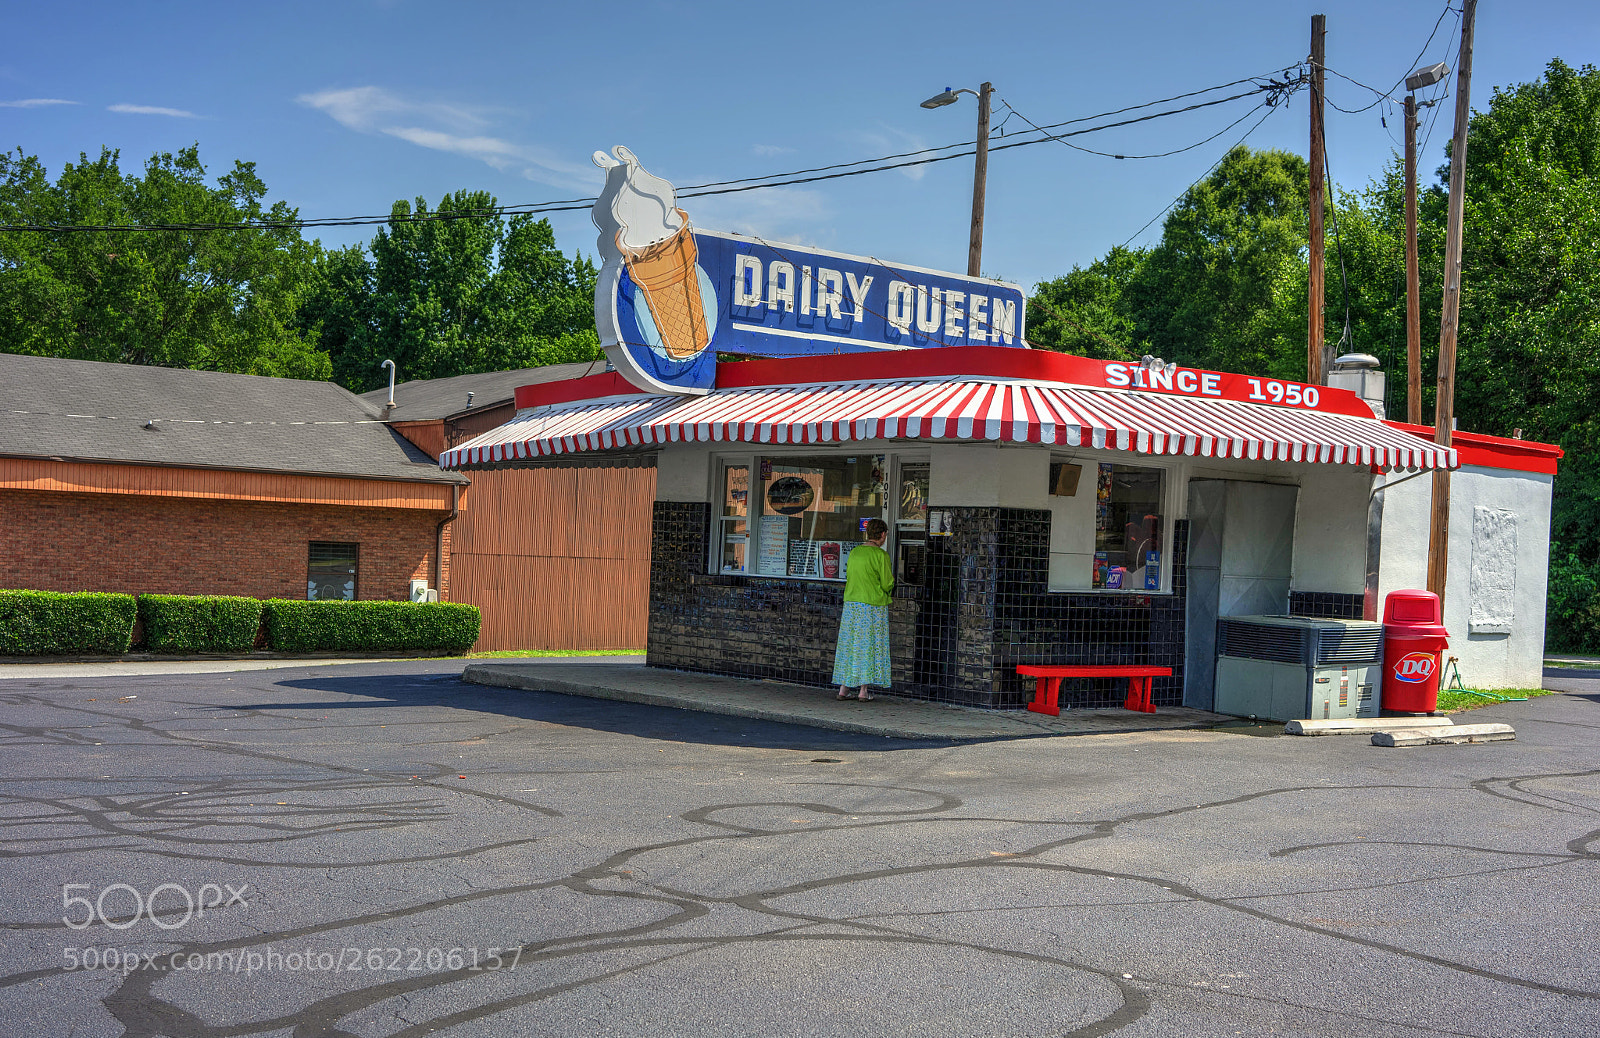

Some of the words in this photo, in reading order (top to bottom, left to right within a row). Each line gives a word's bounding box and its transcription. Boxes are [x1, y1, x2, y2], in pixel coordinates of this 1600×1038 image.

[734, 254, 874, 323] DAIRY
[887, 280, 1016, 345] QUEEN
[1105, 363, 1221, 396] SINCE
[1248, 378, 1319, 408] 1950
[1106, 574, 1121, 583] ADT
[1401, 659, 1431, 676] DQ
